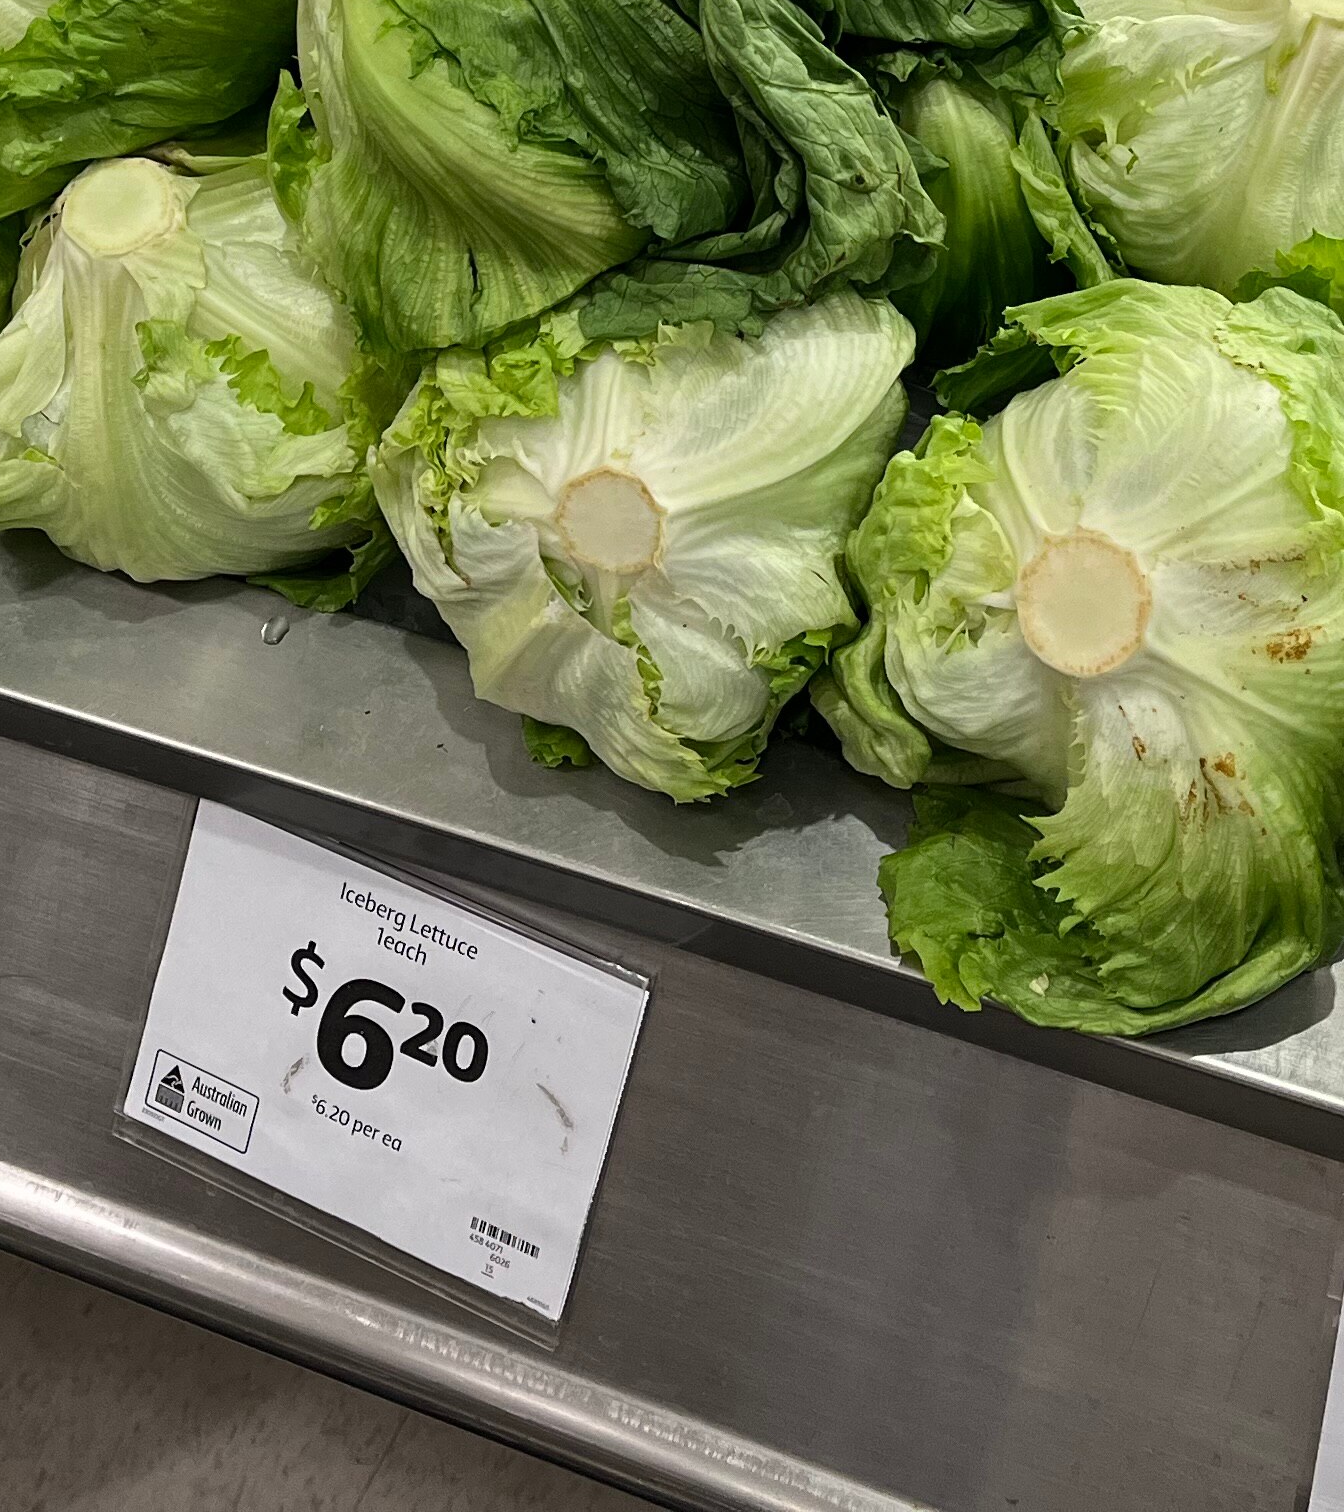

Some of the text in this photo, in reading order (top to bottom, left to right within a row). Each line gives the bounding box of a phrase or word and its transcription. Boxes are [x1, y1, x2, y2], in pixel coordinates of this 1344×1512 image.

[340, 882, 479, 960] Iceberg Lettuce
[376, 927, 428, 965] 1each
[186, 1100, 222, 1131] Grown
[191, 1076, 248, 1117] Australian
[311, 1094, 403, 1152] $6.20 per ea
